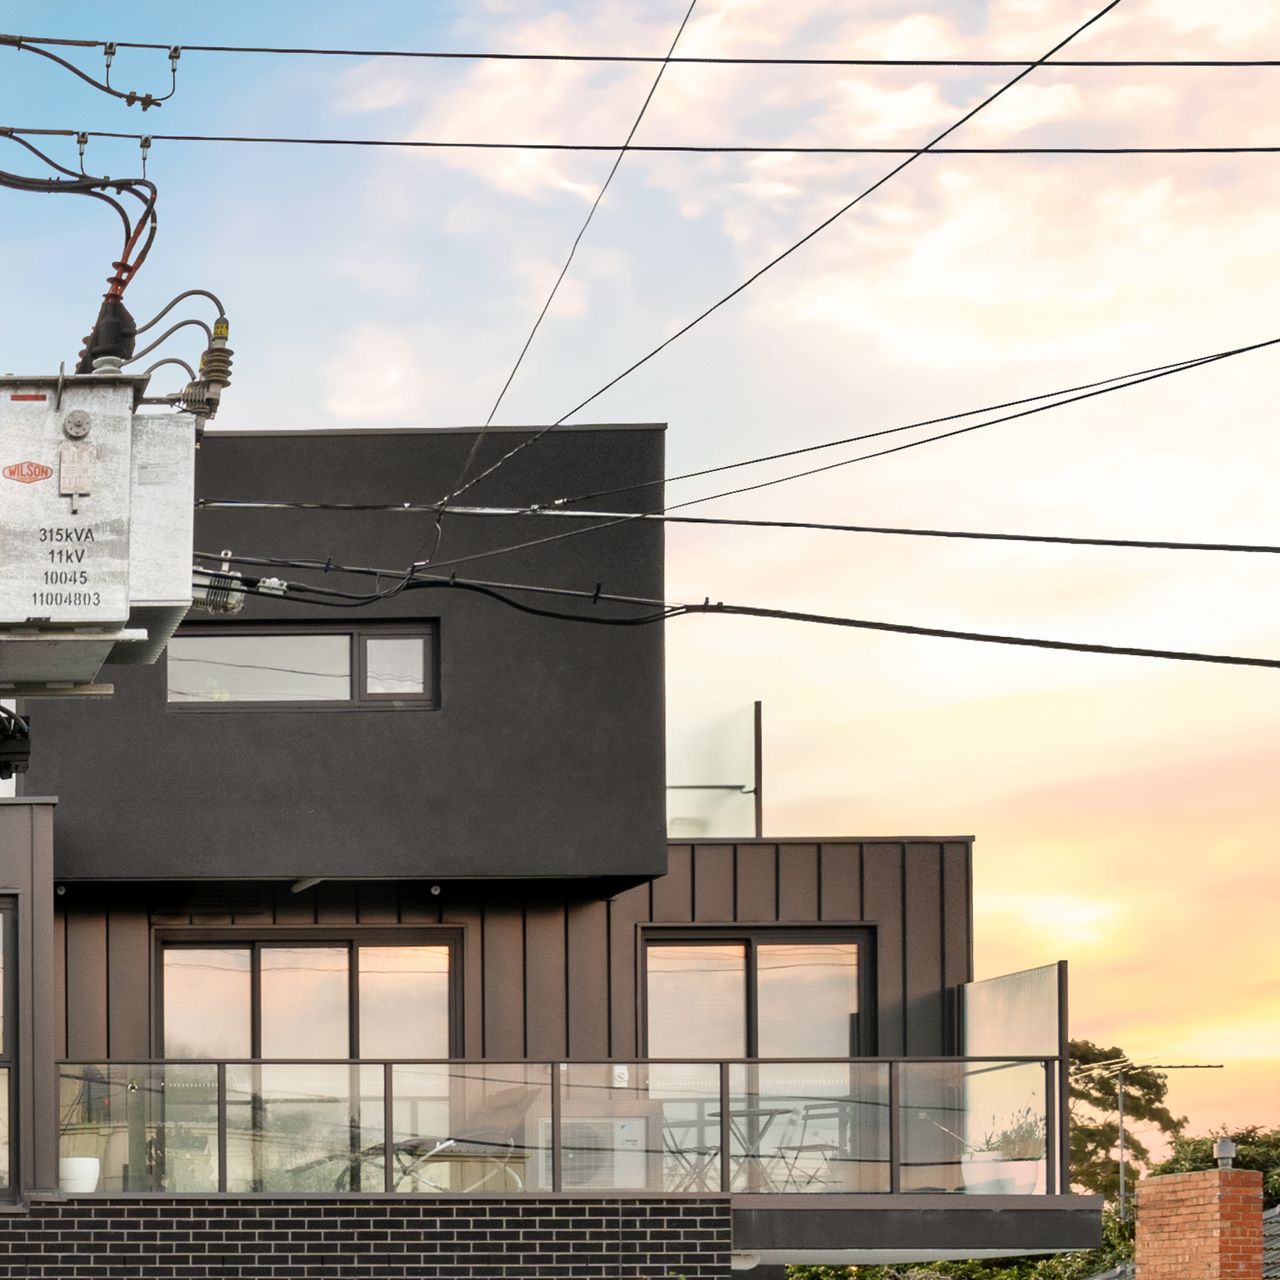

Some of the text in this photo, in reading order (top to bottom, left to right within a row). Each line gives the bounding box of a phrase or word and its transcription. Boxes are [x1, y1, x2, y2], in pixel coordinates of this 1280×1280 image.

[8, 463, 49, 477] WILSON
[39, 528, 95, 542] 315kVA
[48, 549, 86, 563] 11kV
[43, 571, 88, 585] 10045
[32, 592, 101, 606] 11004803
